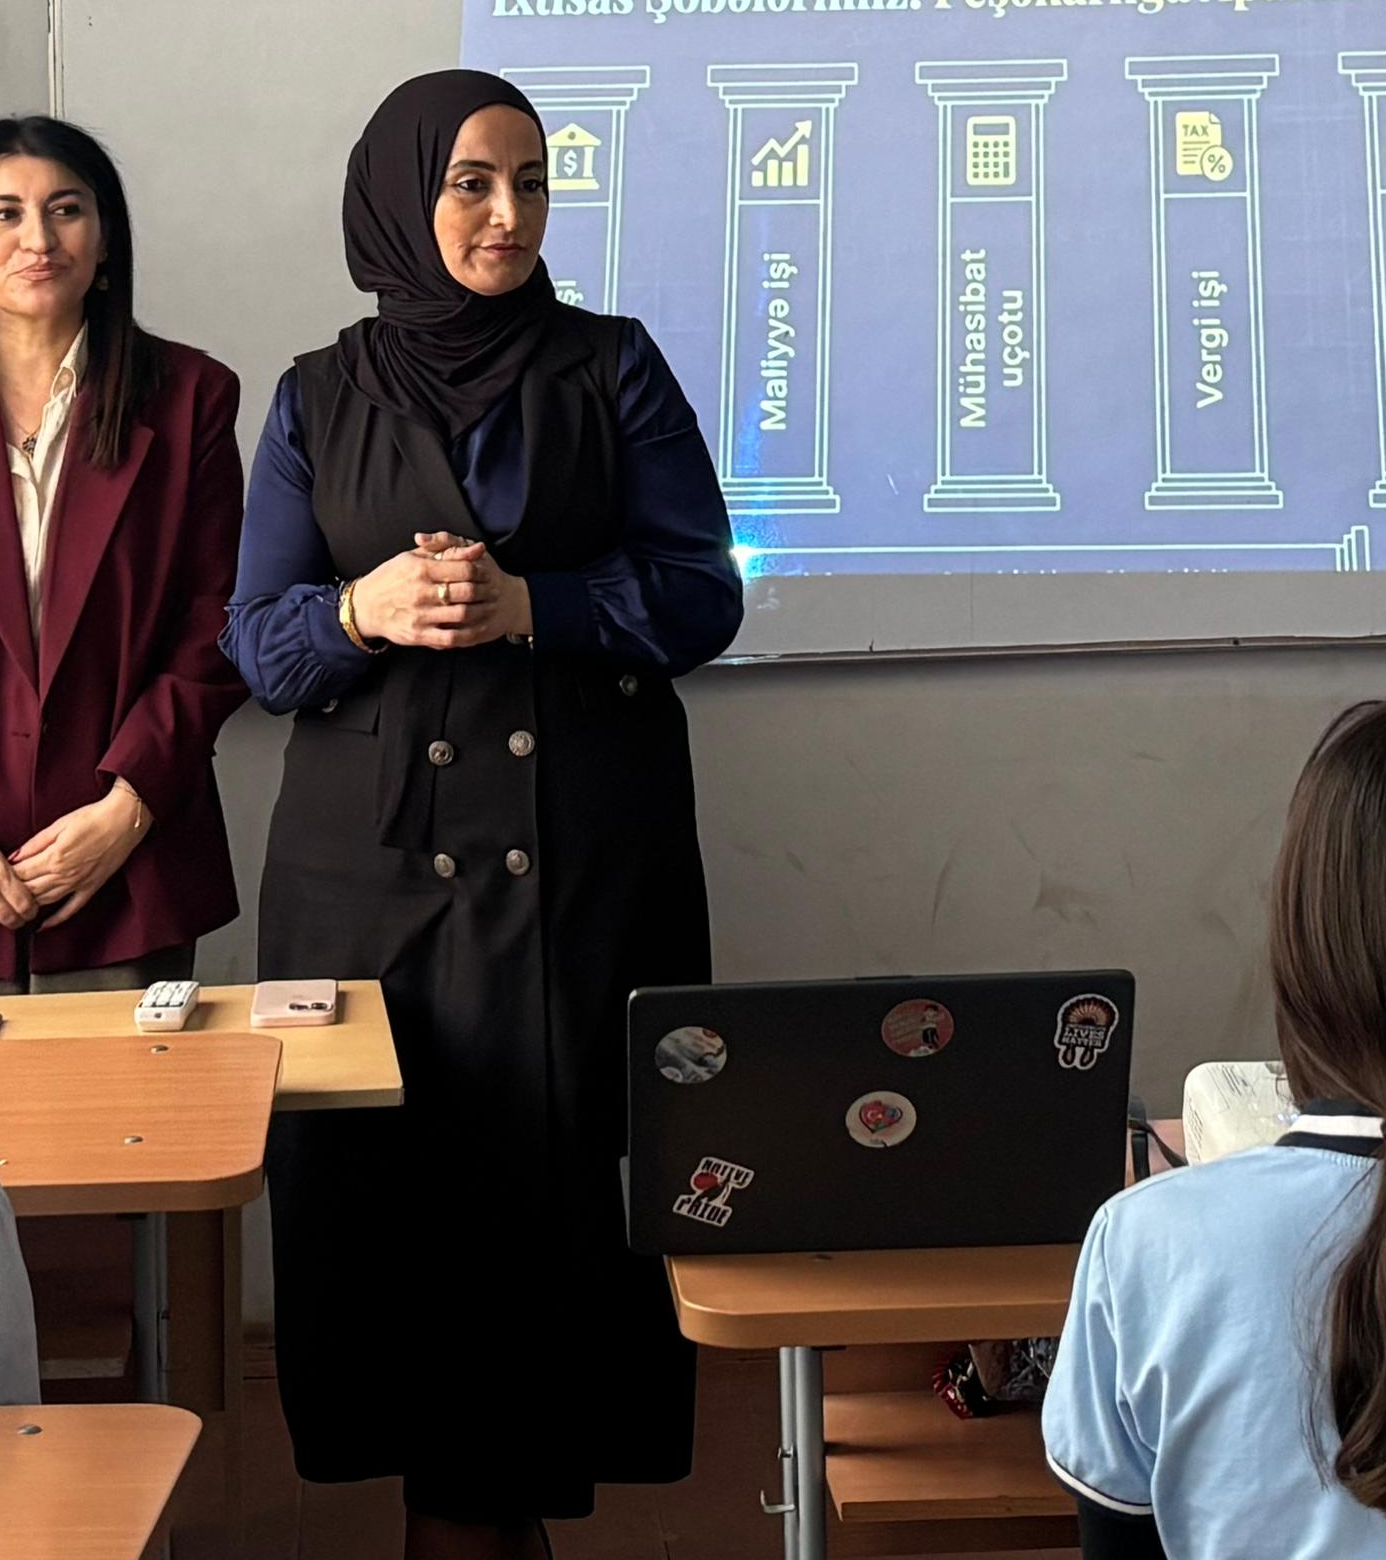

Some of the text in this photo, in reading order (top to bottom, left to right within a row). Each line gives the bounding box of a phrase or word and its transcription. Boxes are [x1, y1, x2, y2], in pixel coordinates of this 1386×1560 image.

[1182, 124, 1210, 138] TAX
[759, 252, 799, 431] Maliyyə işi
[958, 248, 987, 428] Mühasibat
[998, 290, 1031, 388] uçotu
[1191, 270, 1230, 409] Vergi işi
